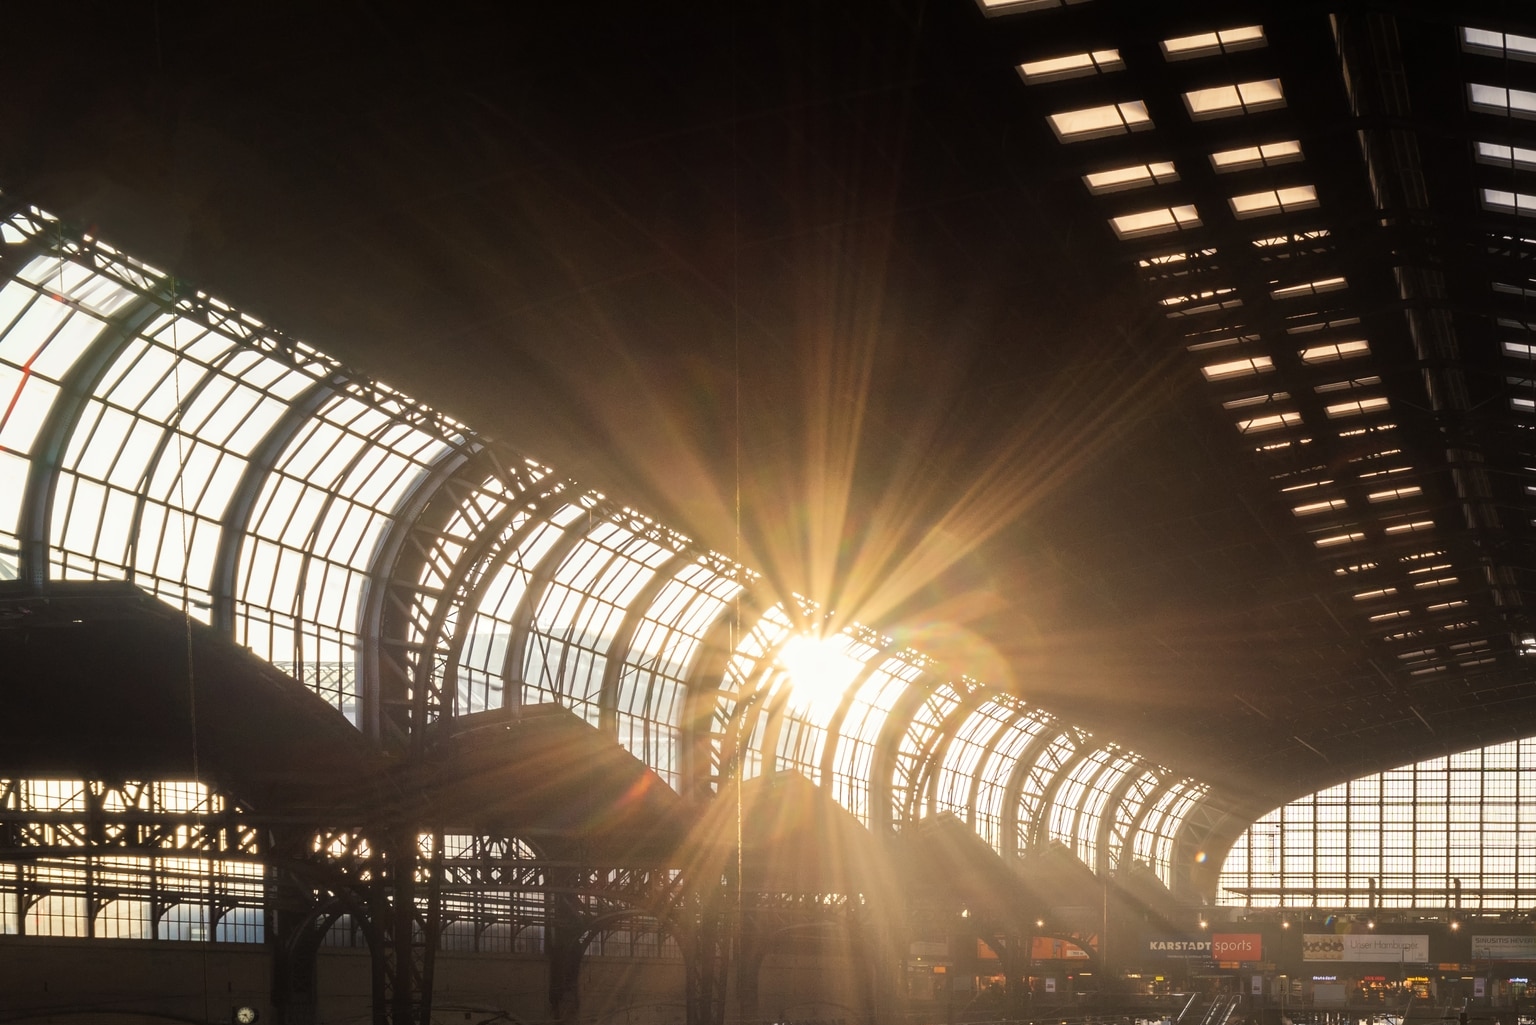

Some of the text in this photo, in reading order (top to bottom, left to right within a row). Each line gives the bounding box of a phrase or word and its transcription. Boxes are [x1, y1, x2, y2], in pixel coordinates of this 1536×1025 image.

[1150, 940, 1252, 953] KARSTADT sports
[1350, 940, 1372, 949] Unser
